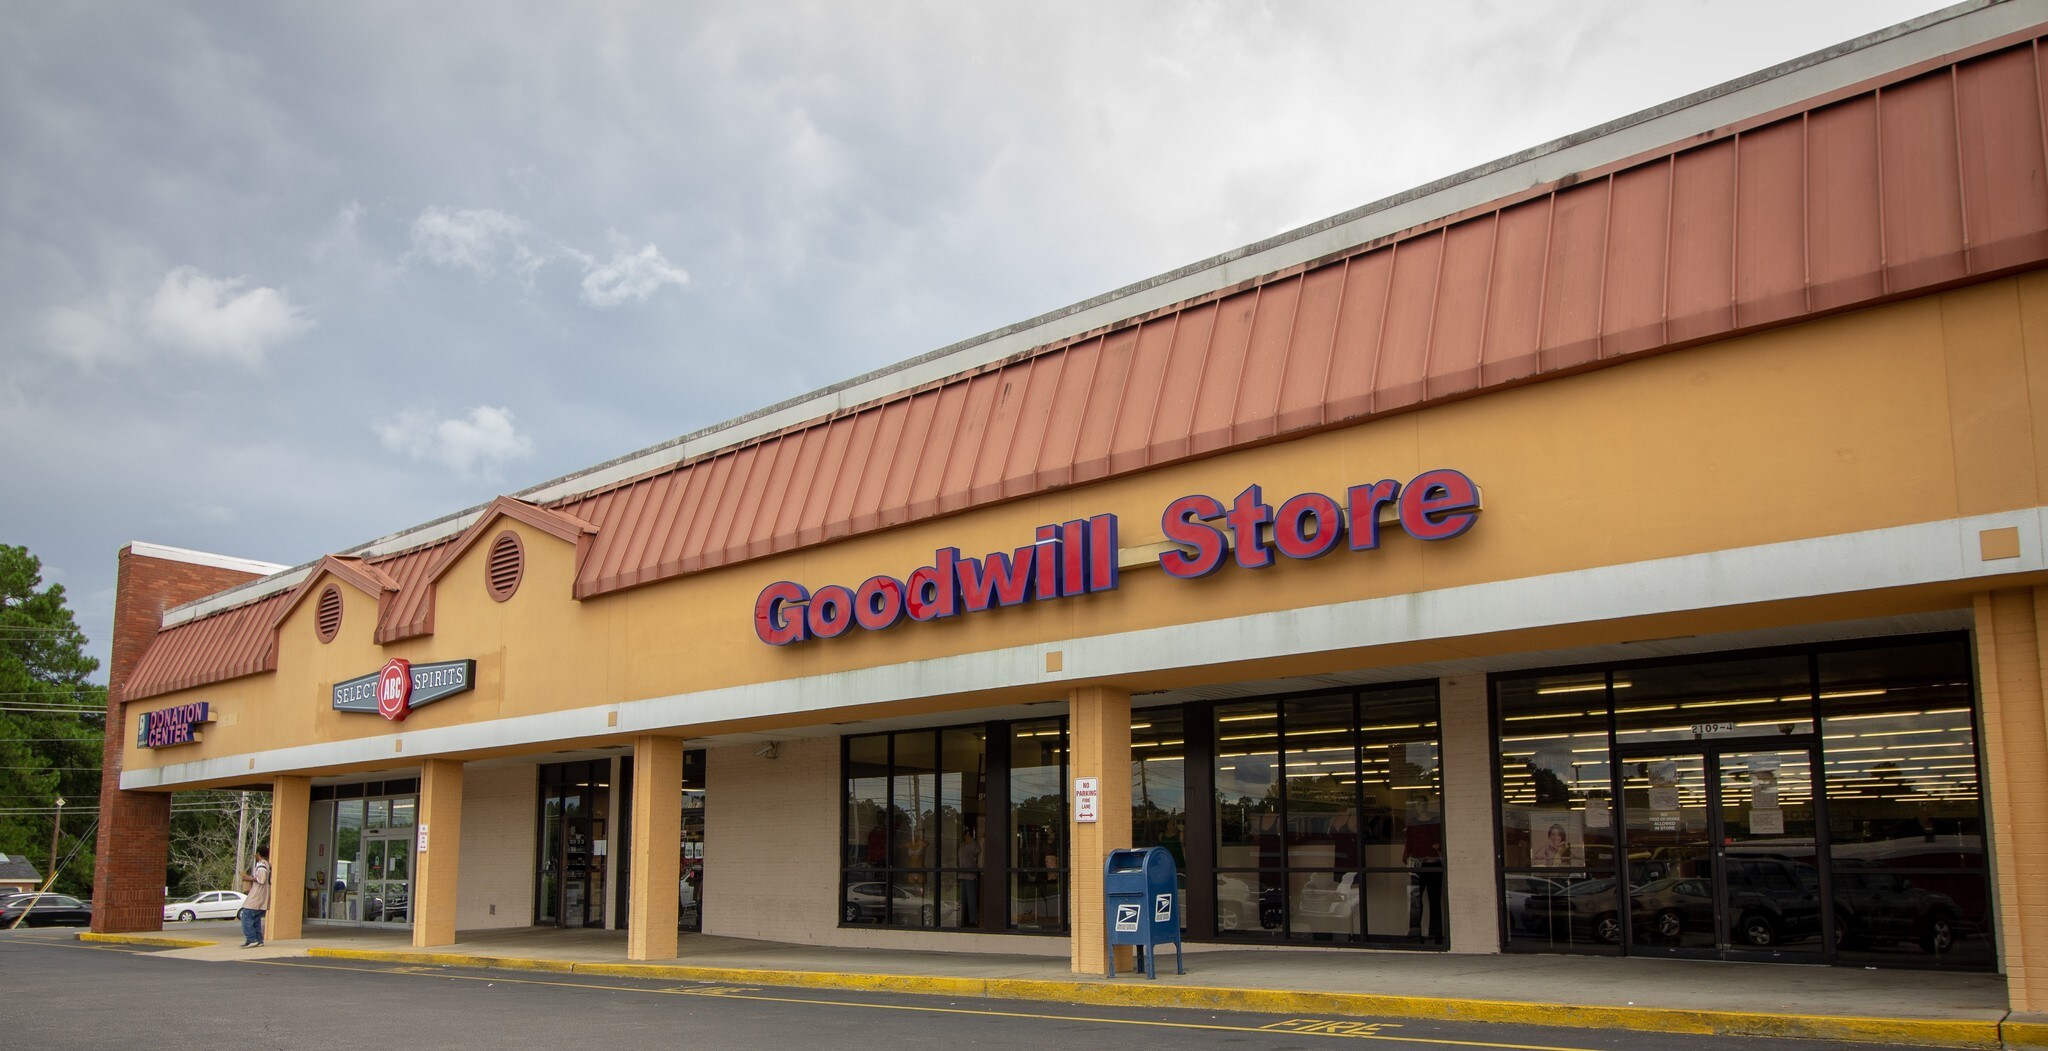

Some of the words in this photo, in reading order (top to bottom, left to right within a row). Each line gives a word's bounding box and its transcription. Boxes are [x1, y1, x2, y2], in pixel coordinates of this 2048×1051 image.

[754, 512, 1119, 647] Goodwill
[1158, 468, 1481, 580] Store
[336, 681, 377, 704] SELECT
[414, 667, 463, 690] SPIRITS
[383, 677, 401, 700] ABC
[150, 703, 203, 729] DONATION
[1691, 723, 1733, 733] 2109-4
[148, 723, 188, 747] CENTER
[1258, 1018, 1405, 1035] FIRE
